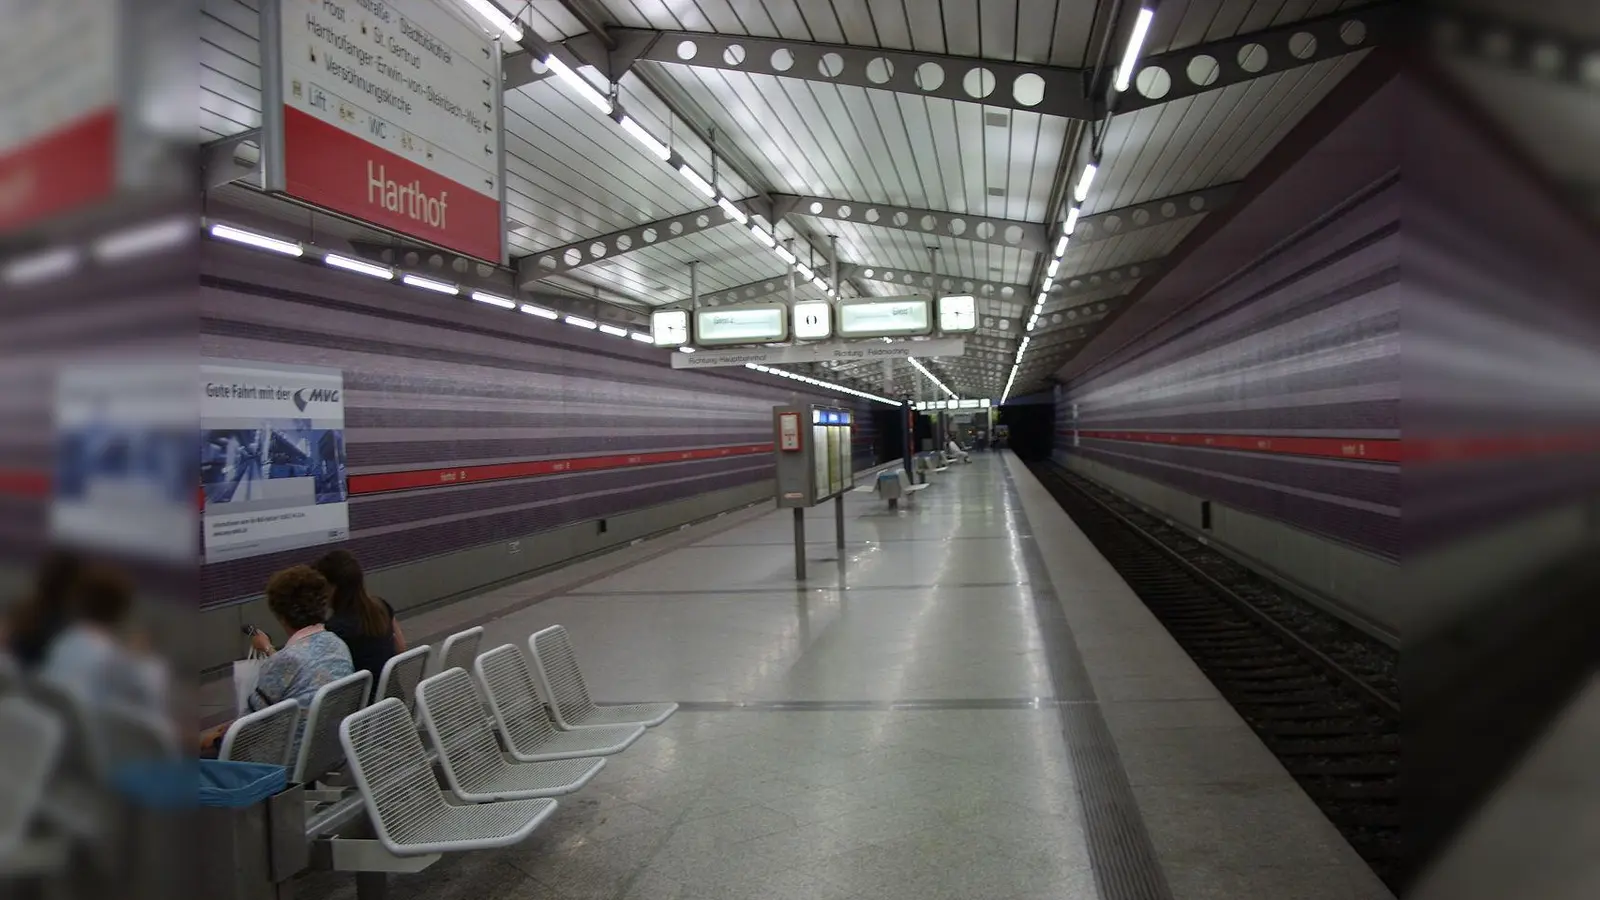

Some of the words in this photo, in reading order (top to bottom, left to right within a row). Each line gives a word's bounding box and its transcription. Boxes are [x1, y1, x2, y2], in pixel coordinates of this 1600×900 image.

[308, 86, 327, 112] Lift
[368, 116, 387, 139] WC
[324, 52, 412, 116] Versöhnungskirche
[367, 160, 448, 230] Harthof
[205, 382, 230, 398] Gute
[232, 382, 257, 399] Fahrt
[259, 384, 275, 400] mit
[276, 385, 291, 401] der
[308, 388, 340, 402] MVG
